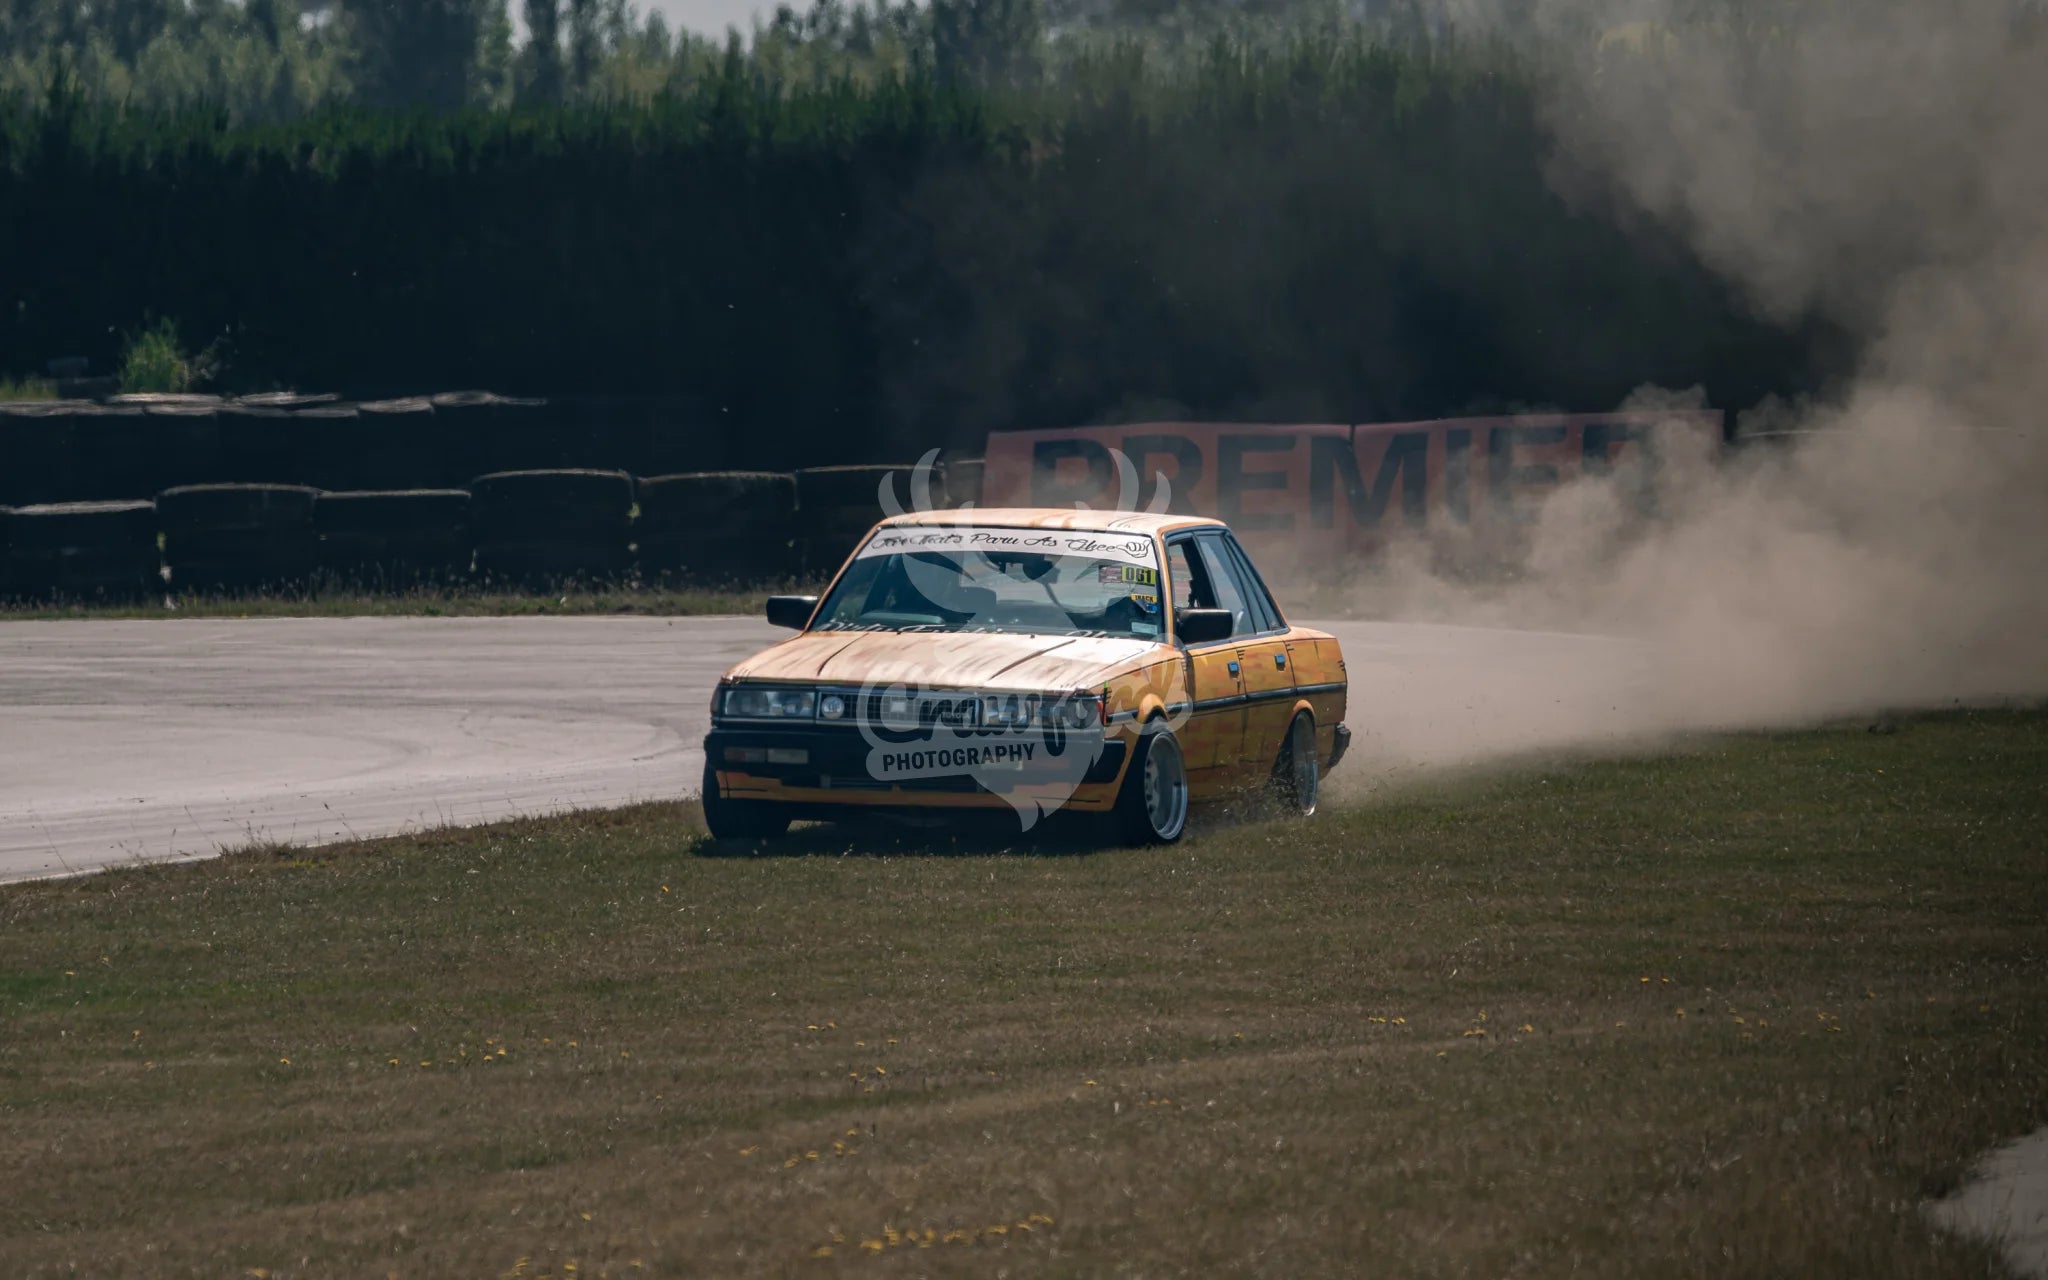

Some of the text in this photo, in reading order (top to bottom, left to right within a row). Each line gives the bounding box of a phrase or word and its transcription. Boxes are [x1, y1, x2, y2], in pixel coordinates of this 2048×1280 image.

[970, 532, 1019, 545] Paru
[1024, 536, 1057, 547] As
[1125, 567, 1152, 584] 061
